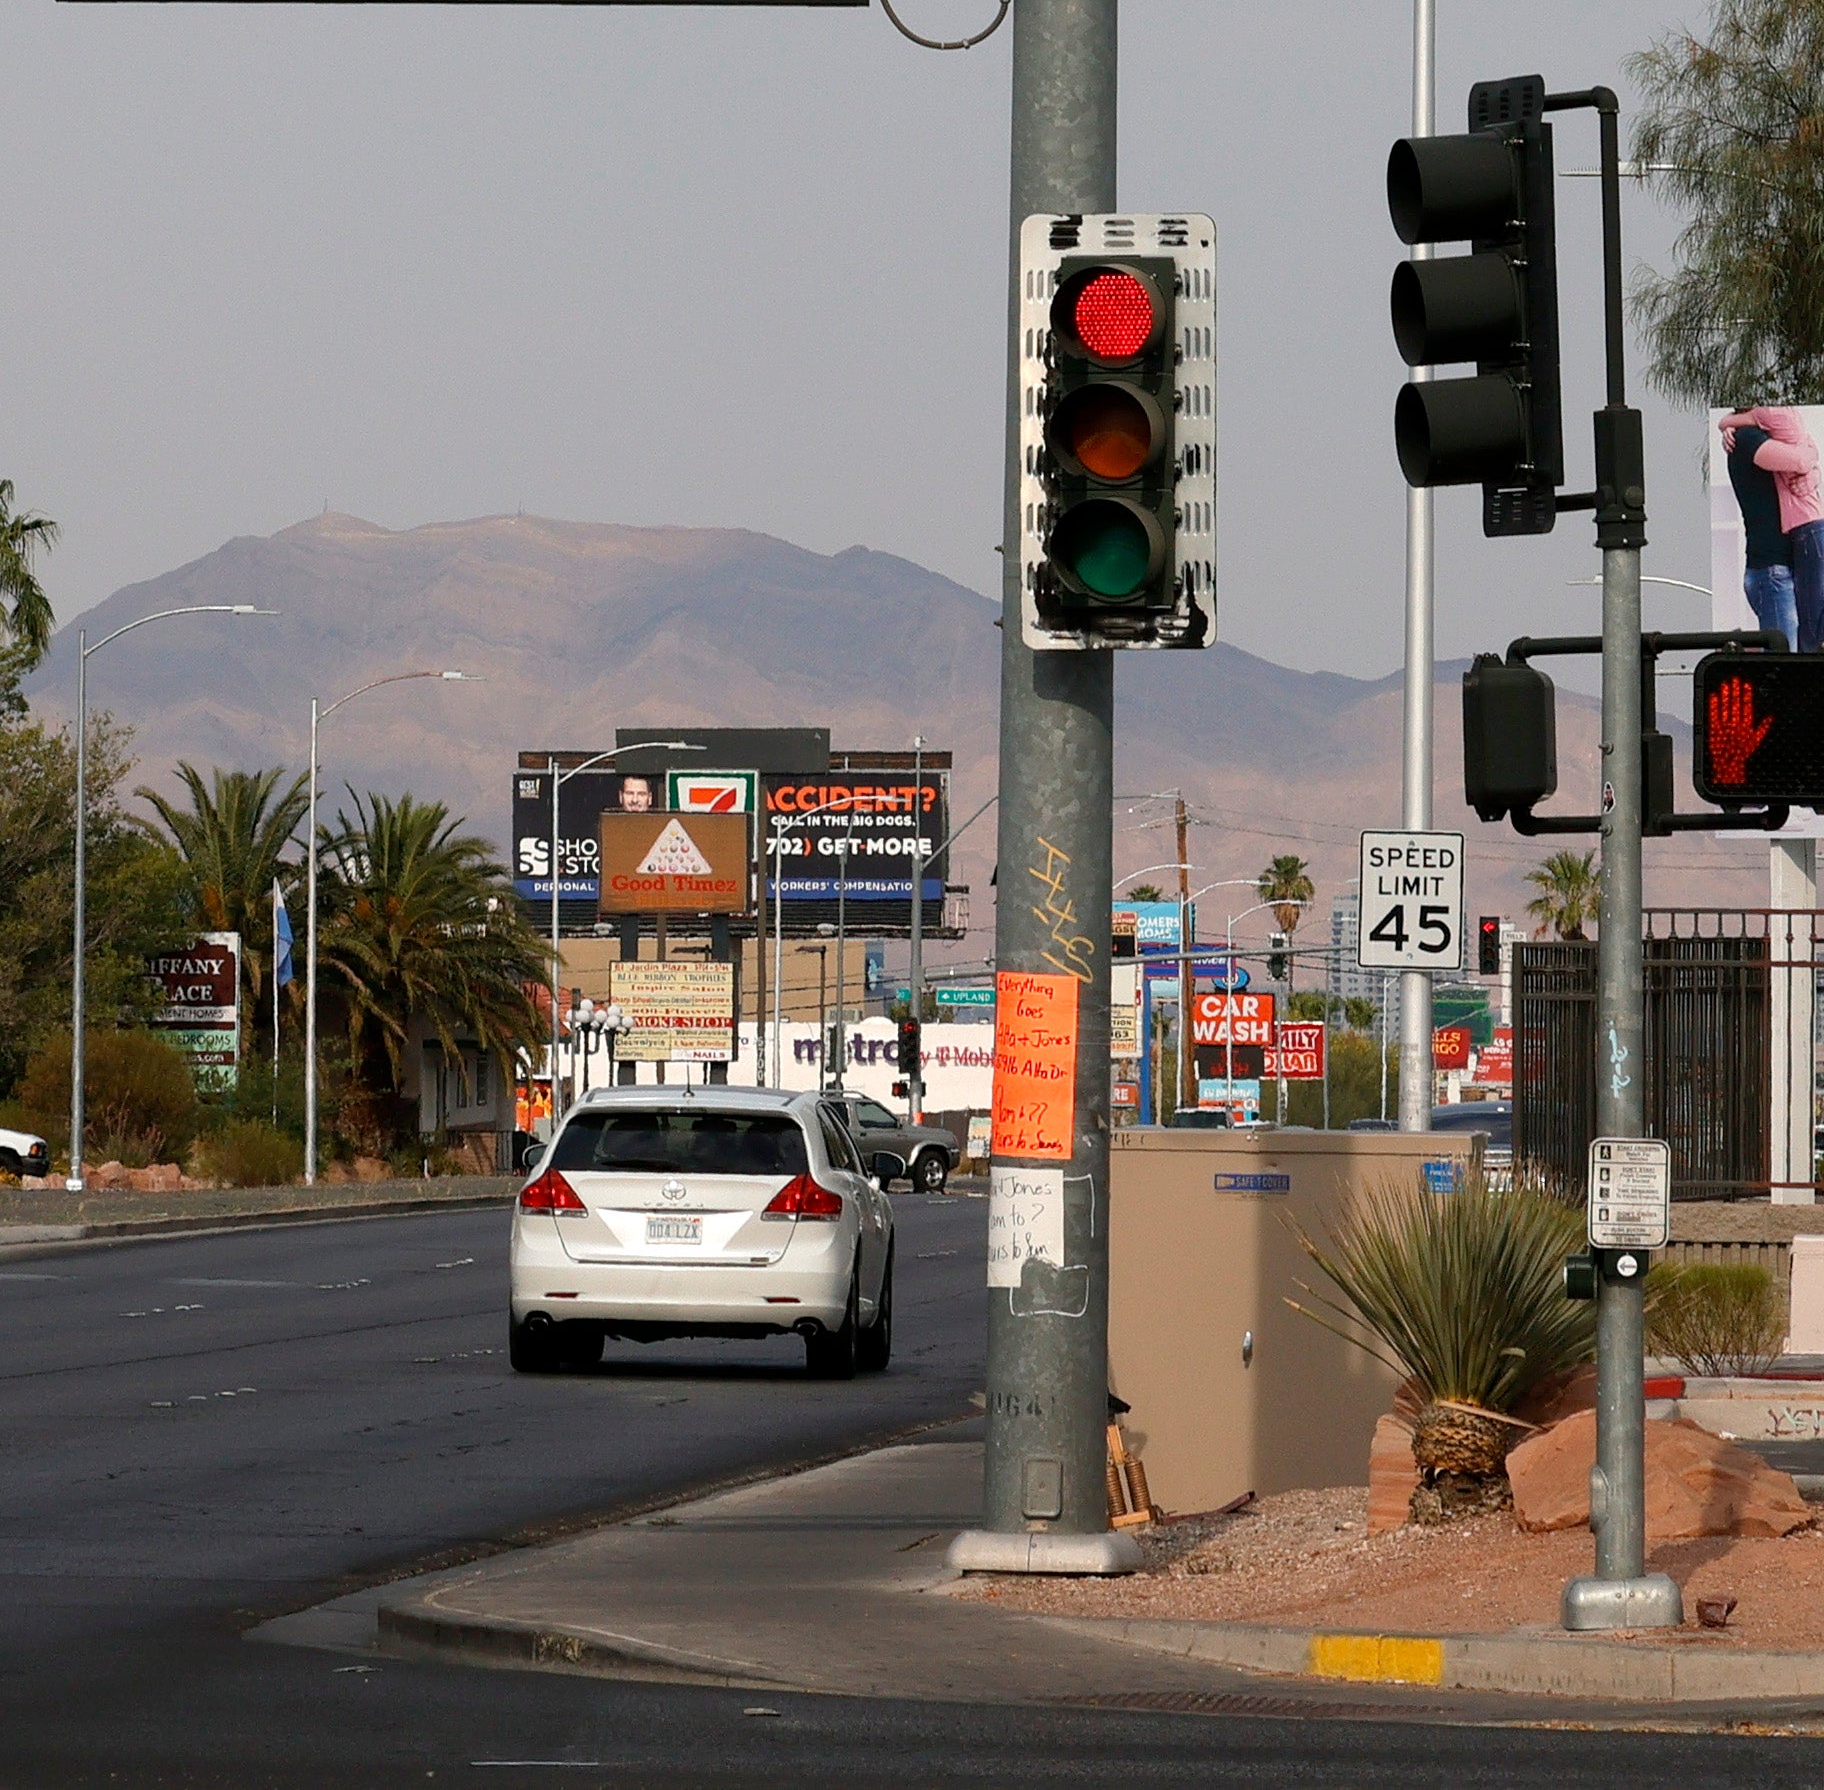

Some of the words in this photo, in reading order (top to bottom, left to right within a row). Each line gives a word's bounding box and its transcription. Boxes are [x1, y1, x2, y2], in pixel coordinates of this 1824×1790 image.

[771, 815, 804, 826] CALL
[808, 816, 820, 826] IN
[825, 816, 848, 826] THE
[852, 816, 873, 826] BIG
[876, 816, 916, 827] DOGS.
[1370, 847, 1454, 868] SPEED
[611, 875, 666, 891] Good
[674, 876, 737, 892] Timez
[834, 881, 914, 891] COMPENSATIO
[1378, 876, 1444, 896] LIMIT
[1369, 905, 1451, 953] 45
[150, 959, 225, 975] IFFANY
[953, 992, 991, 1002] UPLAND
[998, 974, 1054, 1000] Everything
[1016, 999, 1044, 1019] Goes
[1201, 996, 1259, 1018] CAR
[635, 1018, 677, 1027] MOKE
[682, 1018, 730, 1027] SHOP
[1193, 1020, 1269, 1042] WASH
[793, 1033, 899, 1062] mtro
[1004, 1175, 1052, 1198] Jones
